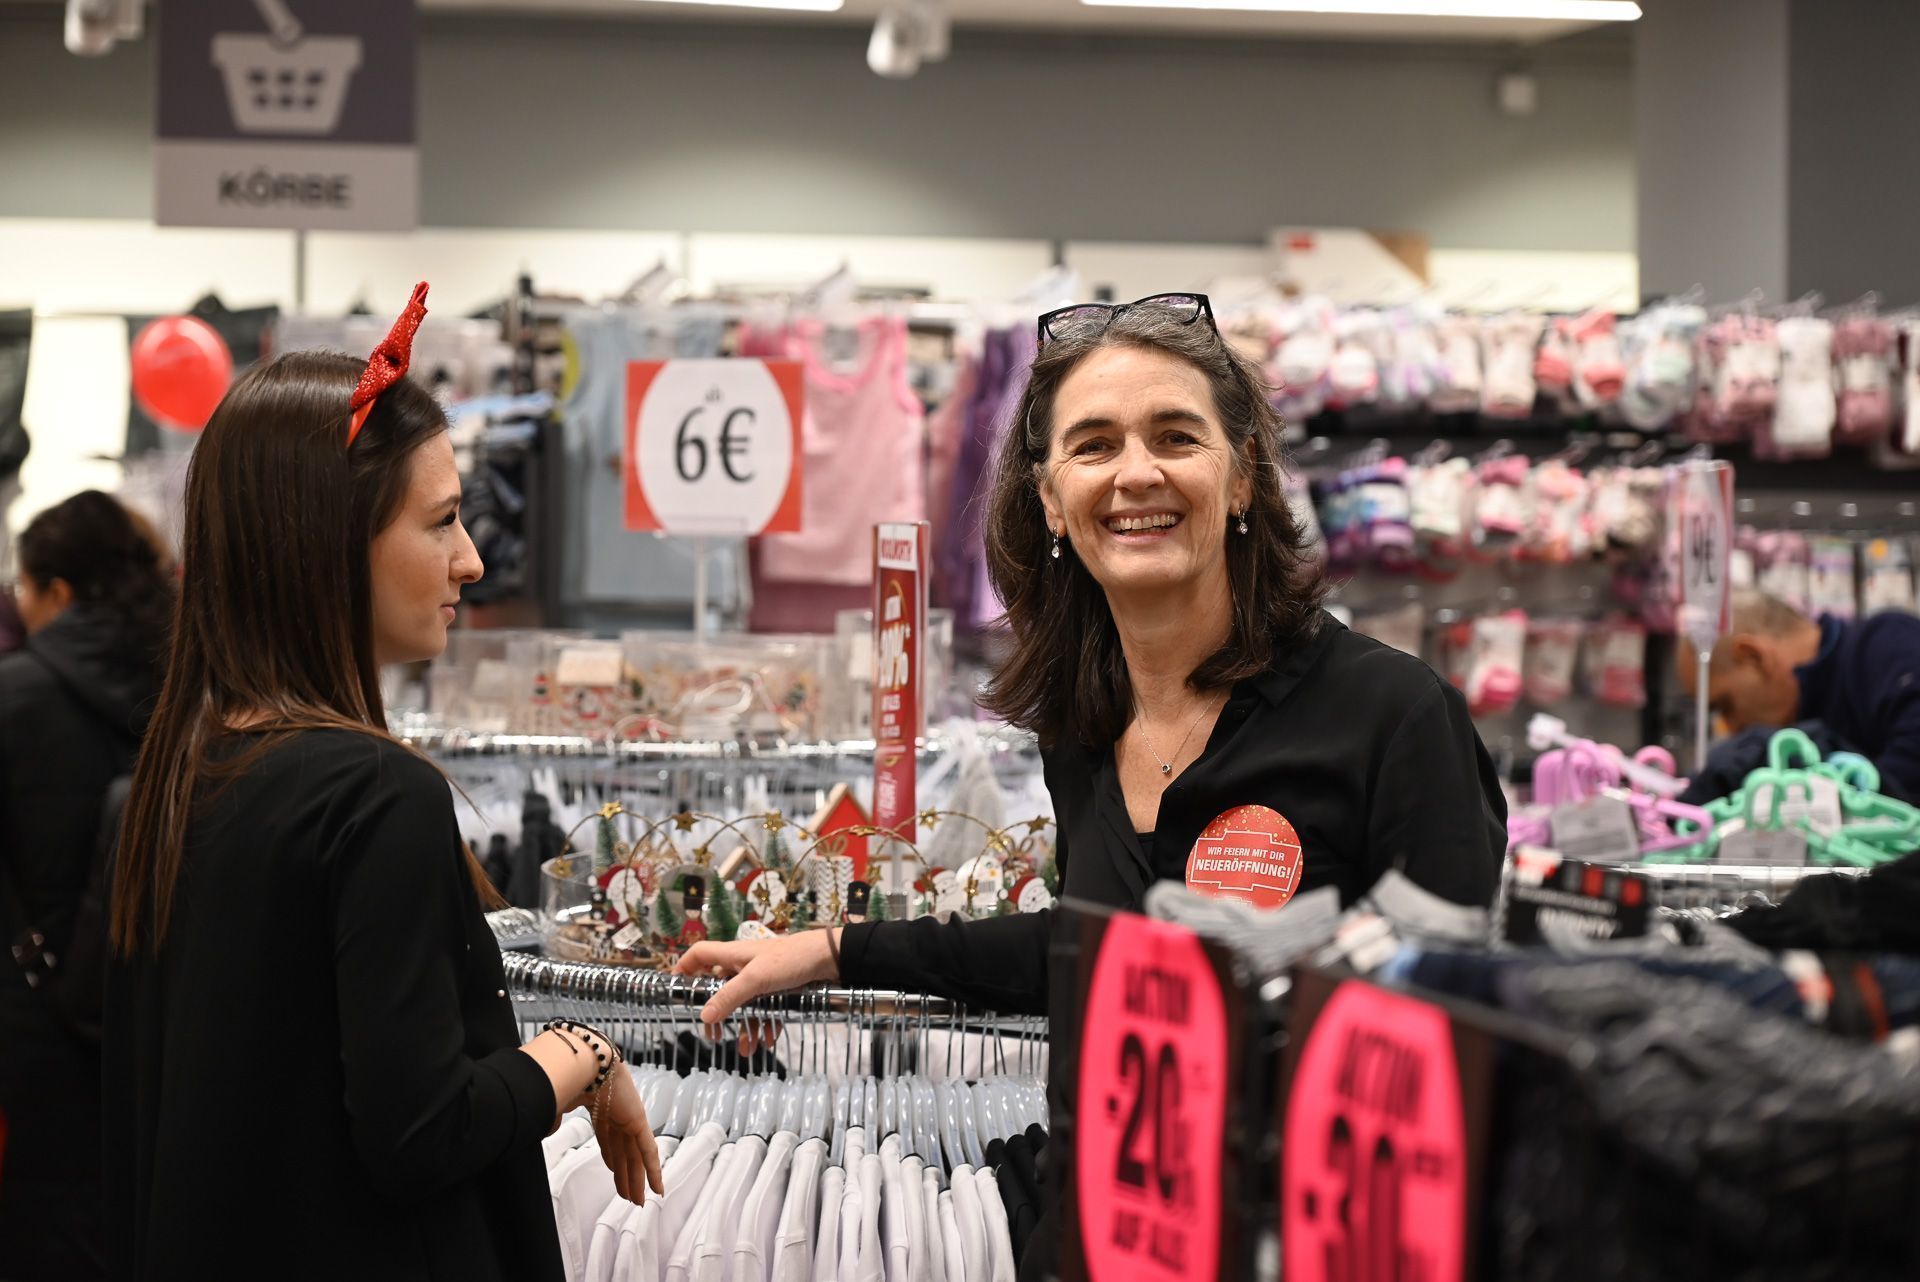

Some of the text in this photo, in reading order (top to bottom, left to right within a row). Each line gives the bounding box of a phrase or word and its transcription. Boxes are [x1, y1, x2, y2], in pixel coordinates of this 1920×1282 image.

[217, 165, 353, 210] KÖRBE
[674, 406, 756, 483] 6€
[1195, 857, 1292, 879] NEUERÖFFNUNG!
[1207, 846, 1285, 862] WIR FEIERN MIT DIR
